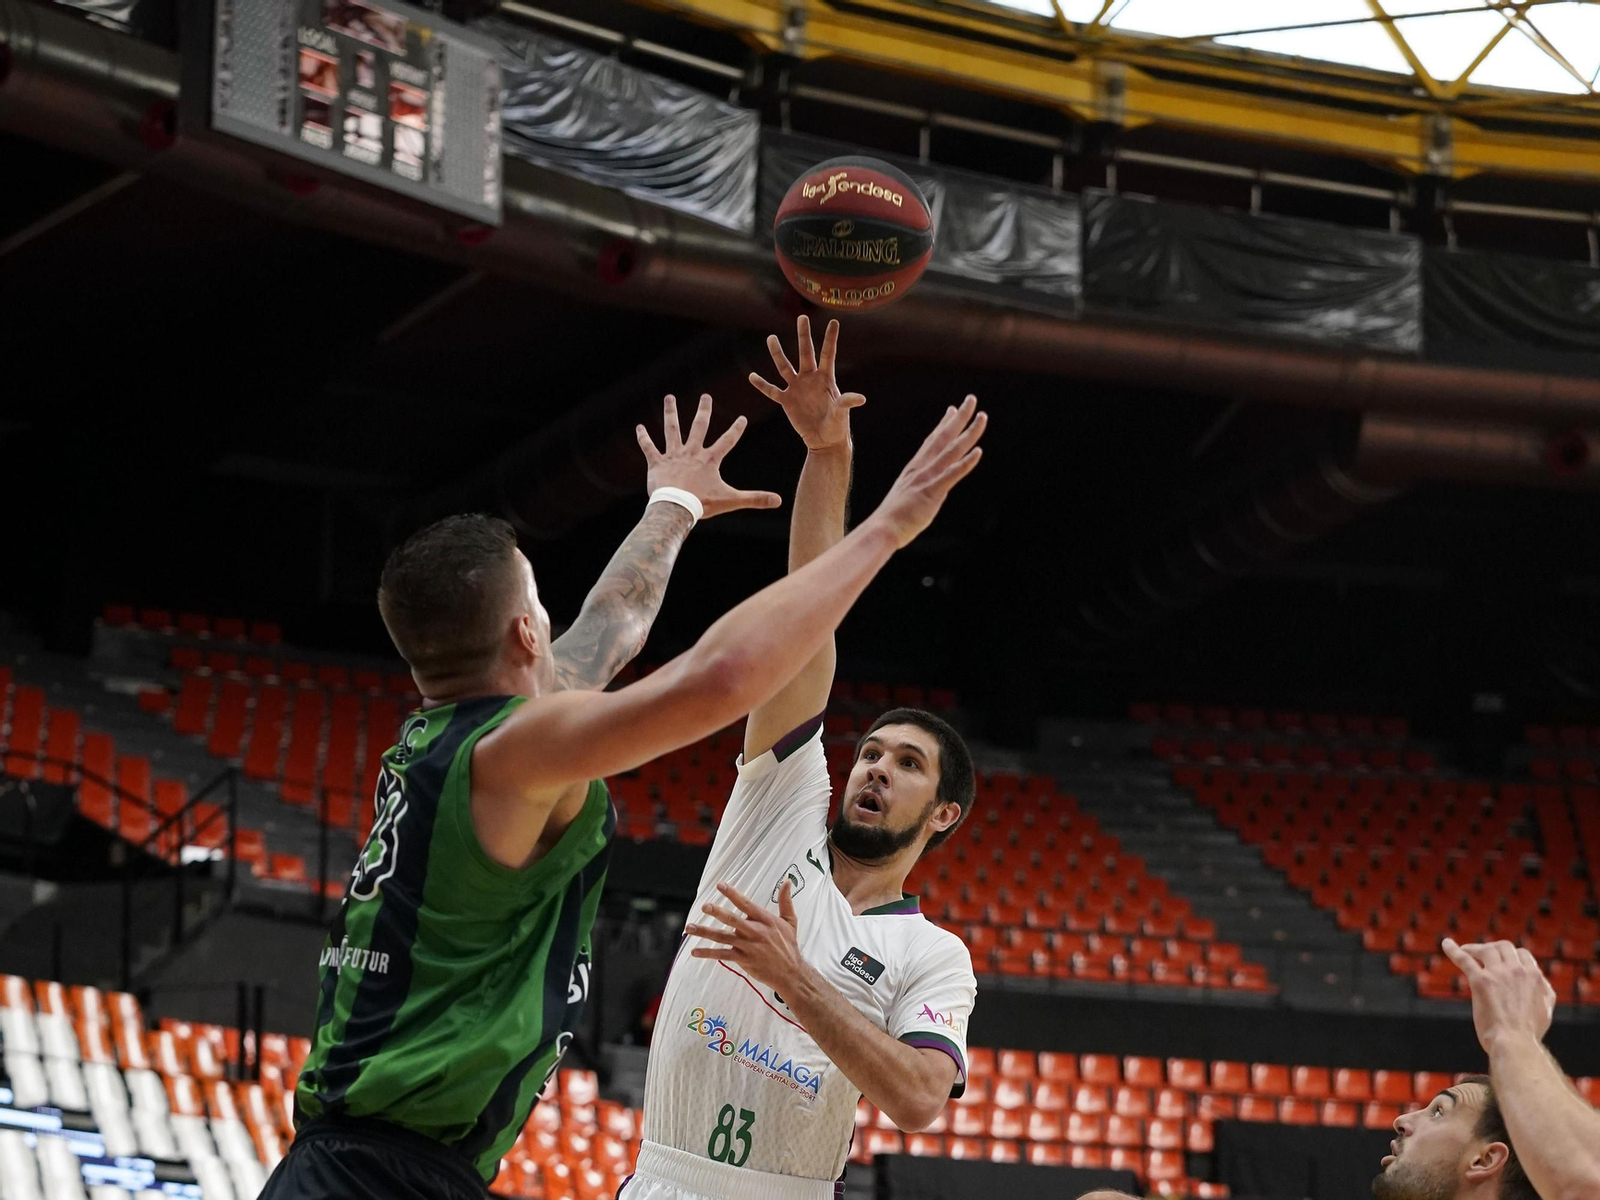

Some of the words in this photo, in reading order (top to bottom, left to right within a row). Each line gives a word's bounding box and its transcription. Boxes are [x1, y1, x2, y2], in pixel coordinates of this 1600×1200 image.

[802, 182, 826, 199] liga
[838, 181, 903, 207] endesa
[844, 959, 875, 983] endesa
[848, 953, 863, 966] liga
[733, 1055, 765, 1075] EUROPEAN
[765, 1071, 789, 1086] CAPITAL
[789, 1082, 800, 1091] OF
[738, 1038, 820, 1094] MÁLAGA
[707, 1103, 756, 1168] 83
